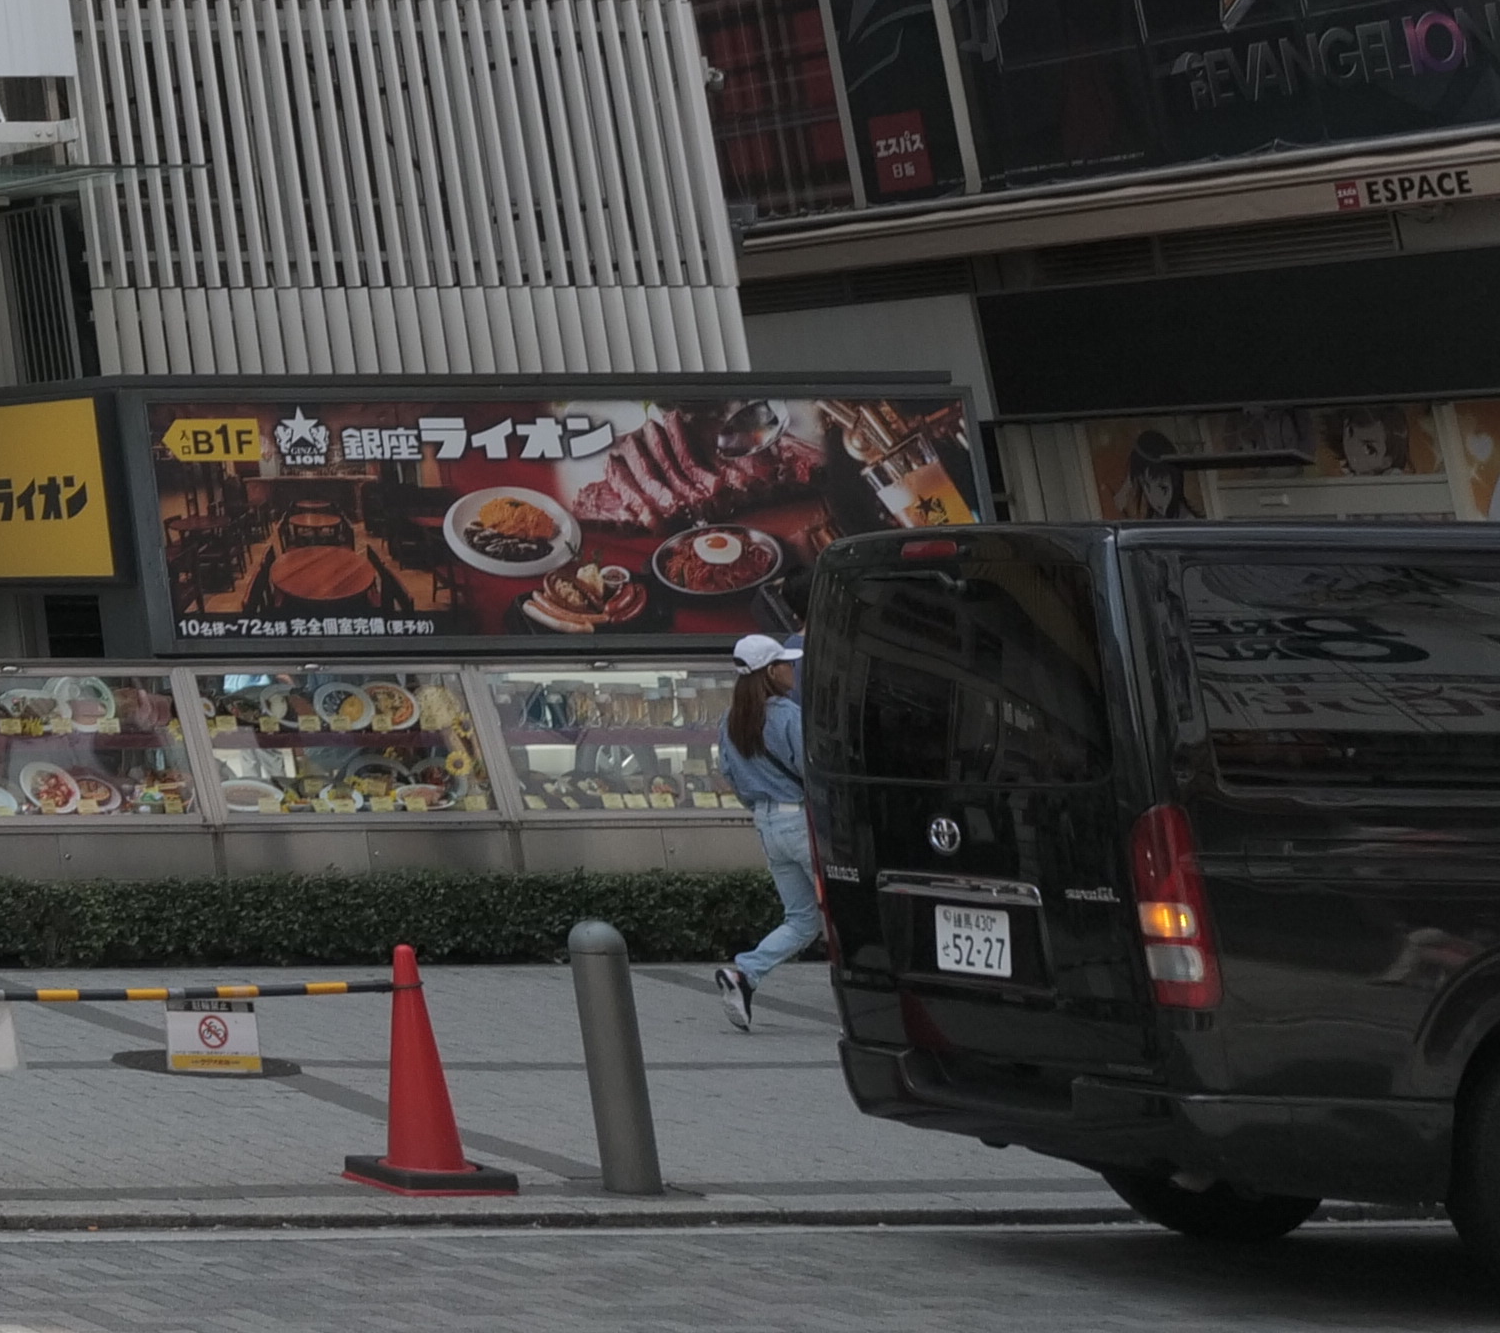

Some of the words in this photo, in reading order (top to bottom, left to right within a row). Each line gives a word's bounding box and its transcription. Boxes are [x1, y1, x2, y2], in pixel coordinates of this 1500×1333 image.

[875, 129, 925, 161] エスパス
[1365, 168, 1474, 206] ESPACE
[191, 423, 254, 457] B1F
[340, 416, 614, 461] 銀座ライオン
[285, 455, 326, 466] LION
[974, 913, 997, 932] 430
[951, 932, 1007, 971] 52-27
